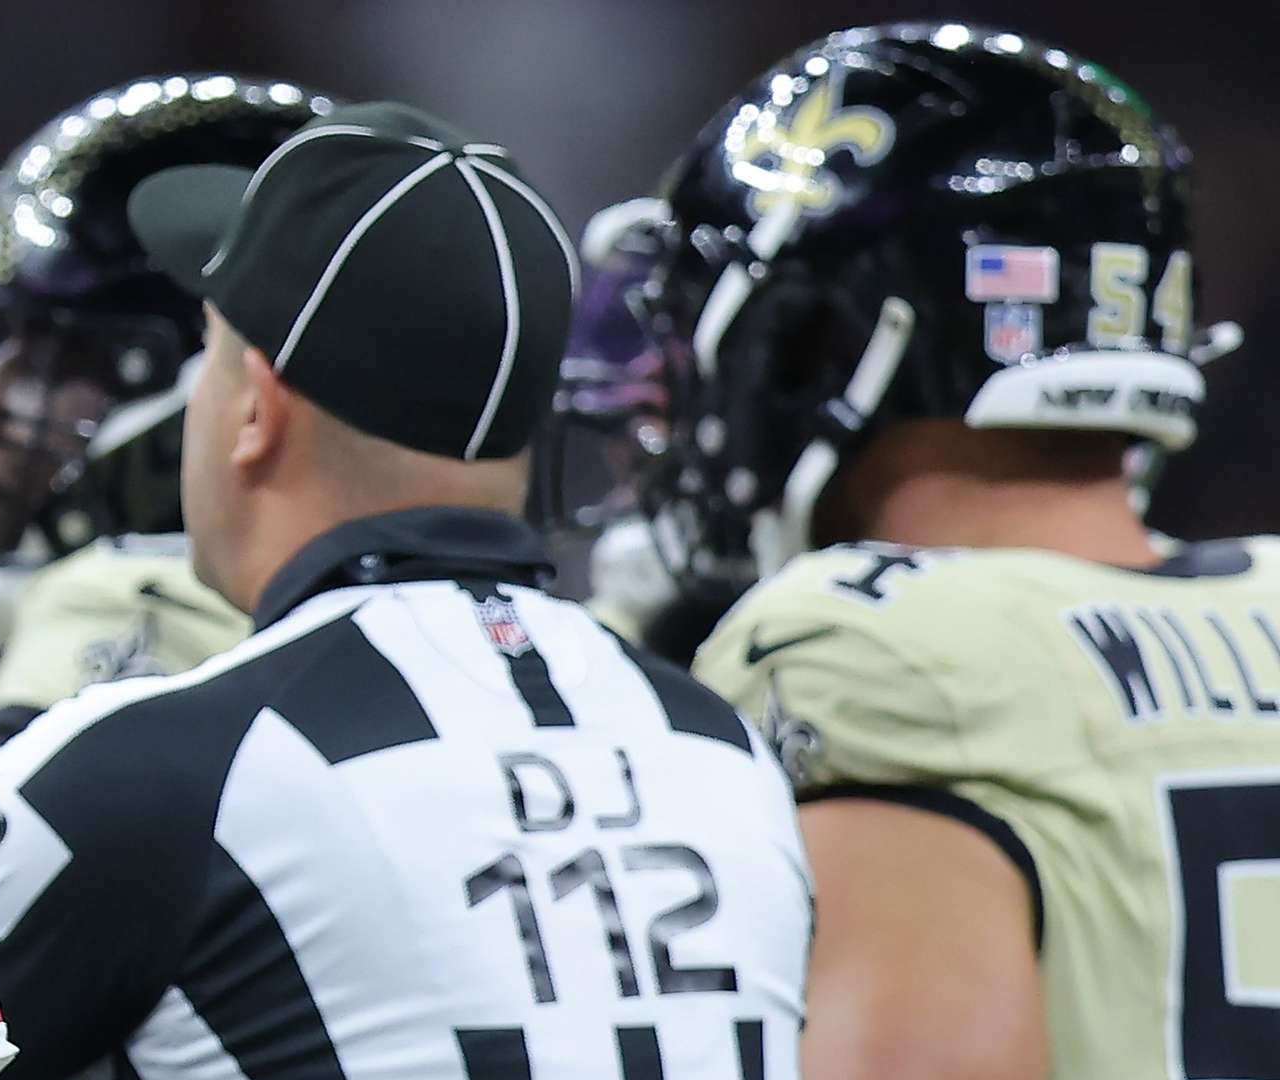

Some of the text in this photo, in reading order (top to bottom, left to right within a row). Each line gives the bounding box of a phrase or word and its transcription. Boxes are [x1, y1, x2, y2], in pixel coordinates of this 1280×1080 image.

[1089, 243, 1192, 354] 54
[497, 747, 641, 831] DJ
[464, 844, 738, 1003] 112
